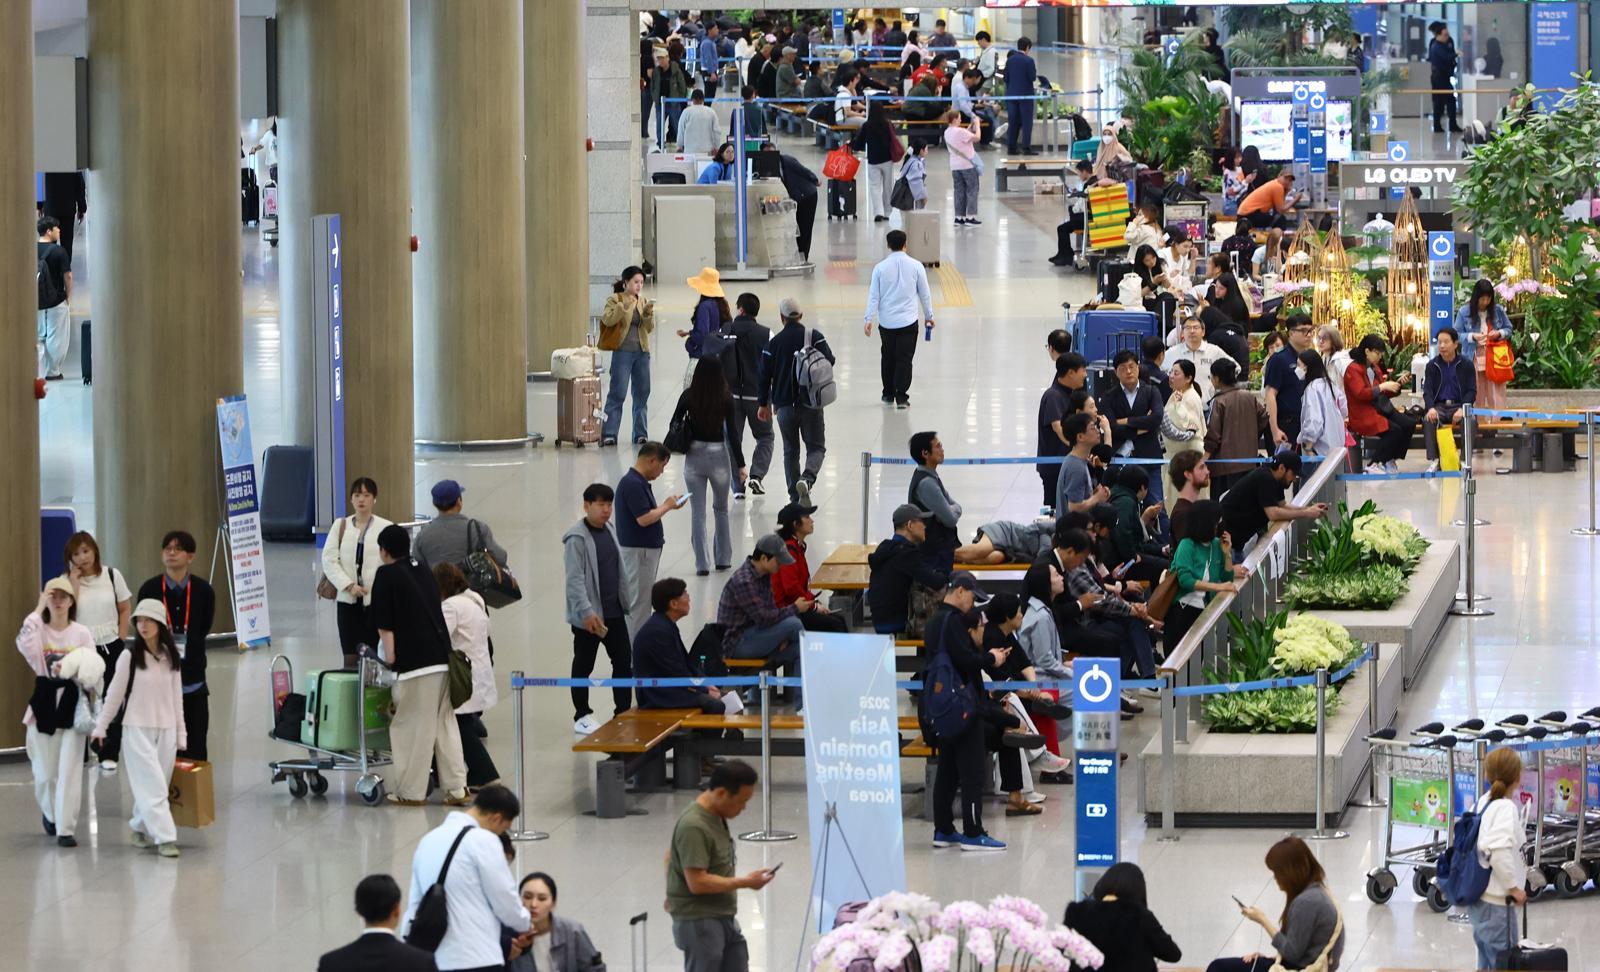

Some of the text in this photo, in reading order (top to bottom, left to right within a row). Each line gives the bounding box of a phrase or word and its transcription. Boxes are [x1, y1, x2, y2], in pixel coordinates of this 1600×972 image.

[1267, 81, 1326, 93] SAMNG
[1365, 167, 1456, 183] LG OLED TV
[242, 470, 252, 482] 금지
[243, 484, 253, 497] 금지
[1077, 721, 1111, 729] HARGE
